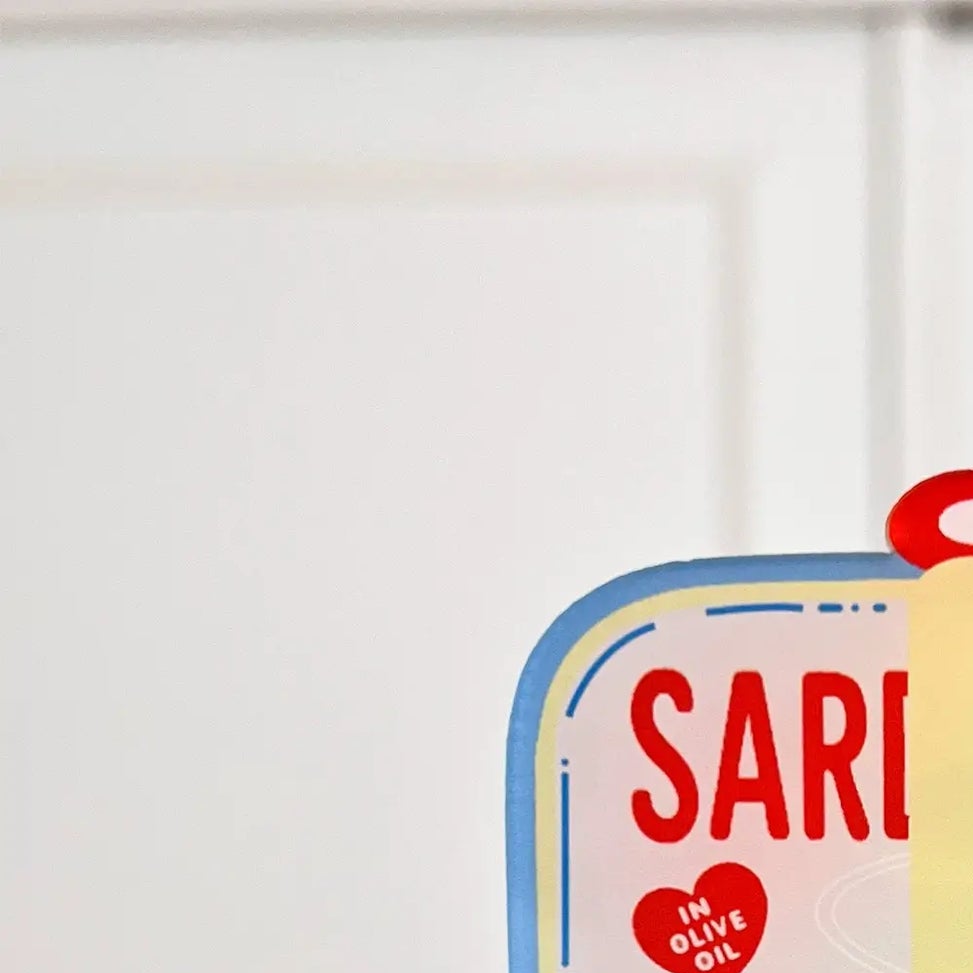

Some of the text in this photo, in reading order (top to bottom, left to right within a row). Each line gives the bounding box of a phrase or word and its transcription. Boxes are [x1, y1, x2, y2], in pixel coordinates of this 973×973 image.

[678, 897, 712, 925] IN
[669, 909, 748, 955] OLIVE
[694, 942, 742, 972] OIL
